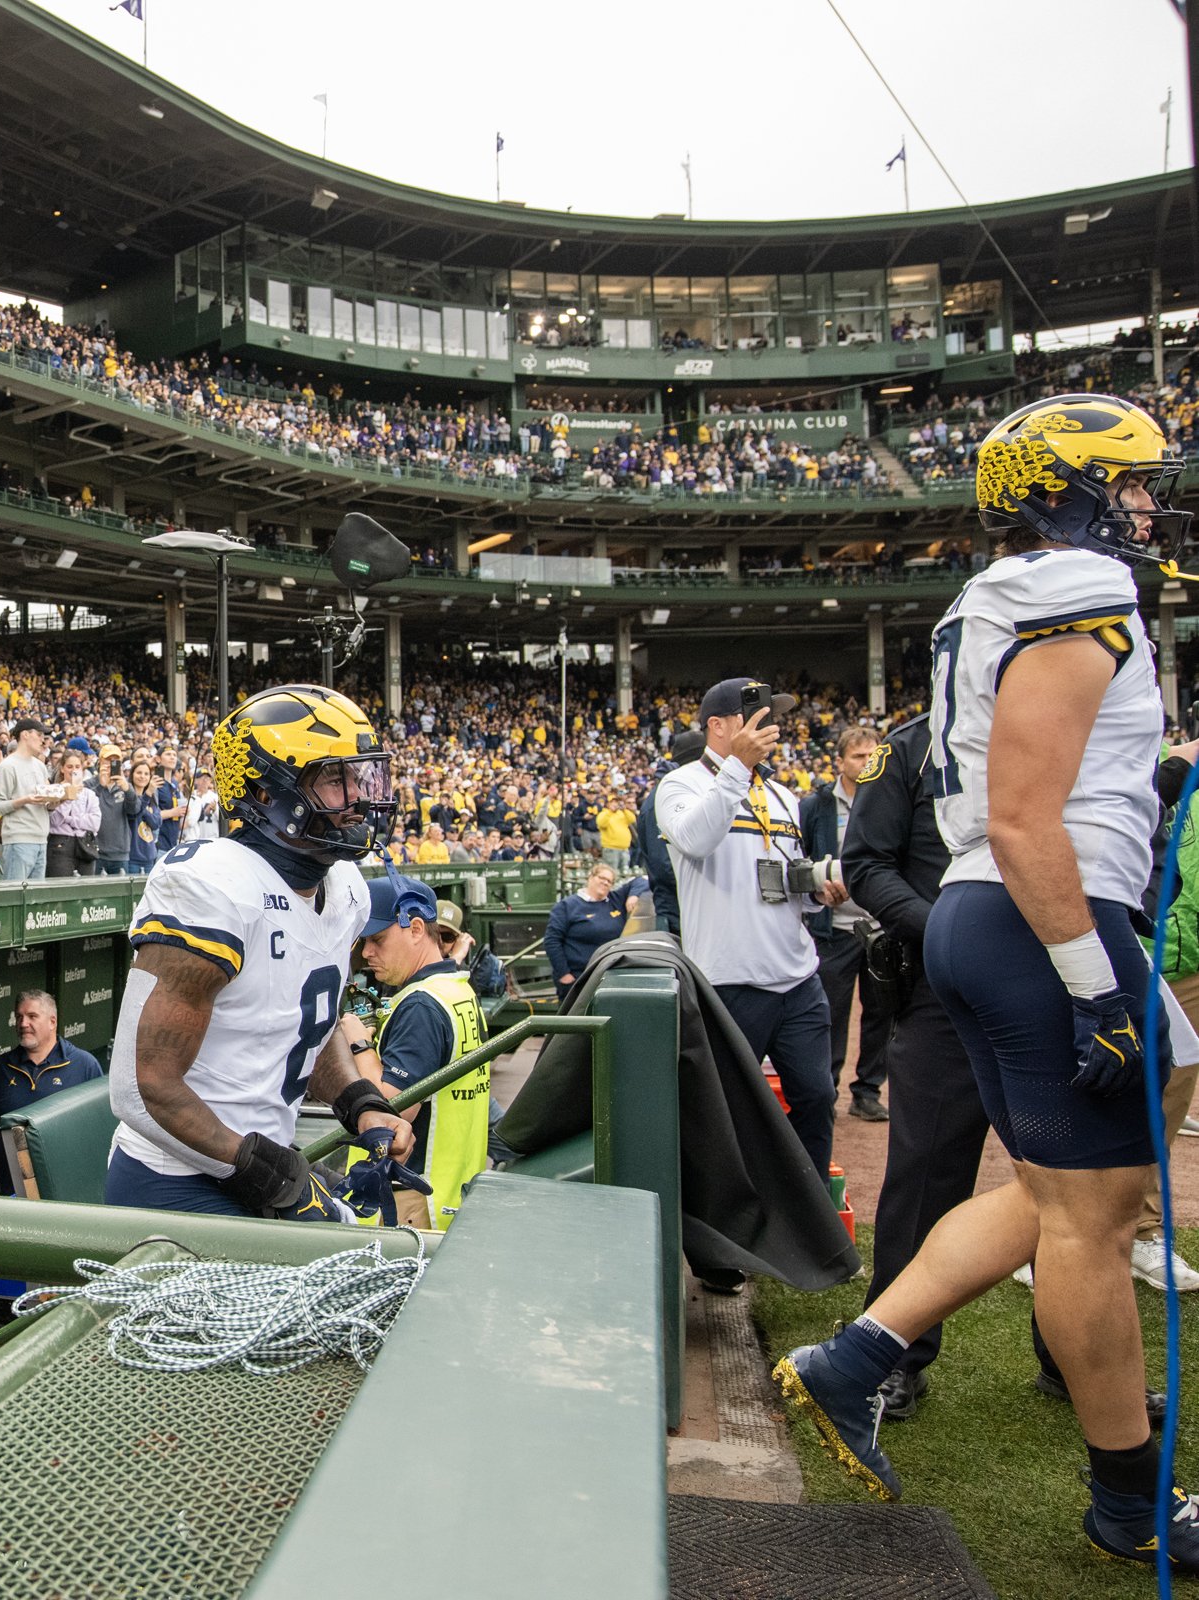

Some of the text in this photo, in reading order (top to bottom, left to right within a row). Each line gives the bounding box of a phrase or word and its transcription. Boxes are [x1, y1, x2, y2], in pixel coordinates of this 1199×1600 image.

[546, 357, 590, 372] MARQUEE
[716, 415, 848, 432] CATALINA CLUB
[270, 930, 286, 960] C
[280, 964, 341, 1107] 8
